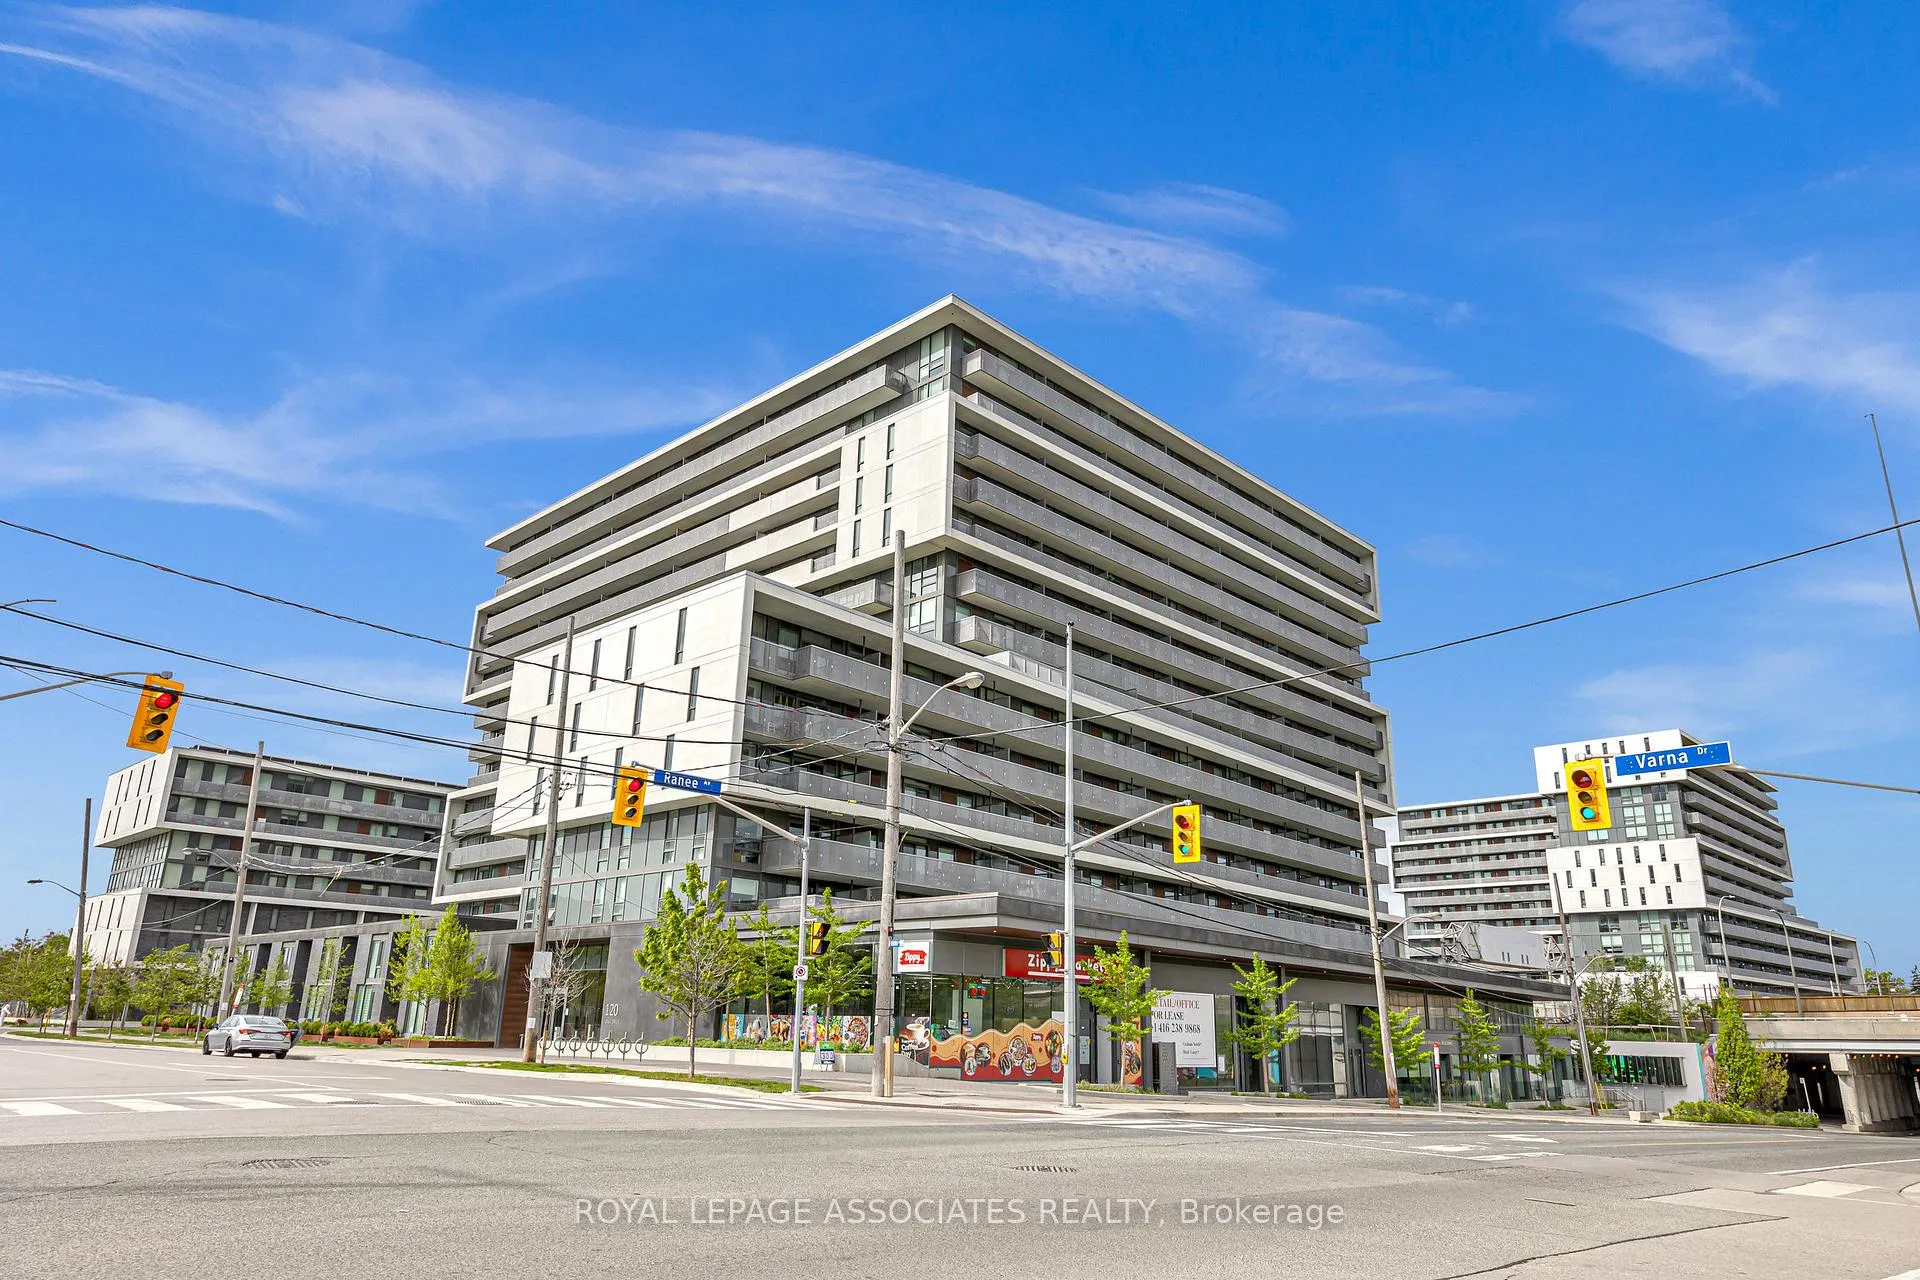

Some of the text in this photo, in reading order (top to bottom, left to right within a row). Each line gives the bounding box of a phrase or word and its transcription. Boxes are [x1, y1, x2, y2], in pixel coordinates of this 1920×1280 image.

[1635, 747, 1708, 769] Varna Dr
[664, 772, 699, 788] Ranee
[604, 1003, 619, 1016] 120
[1164, 1011, 1185, 1021] LEASE
[1158, 1022, 1170, 1033] 416
[1171, 1022, 1183, 1033] 238
[1184, 1023, 1201, 1034] 9868
